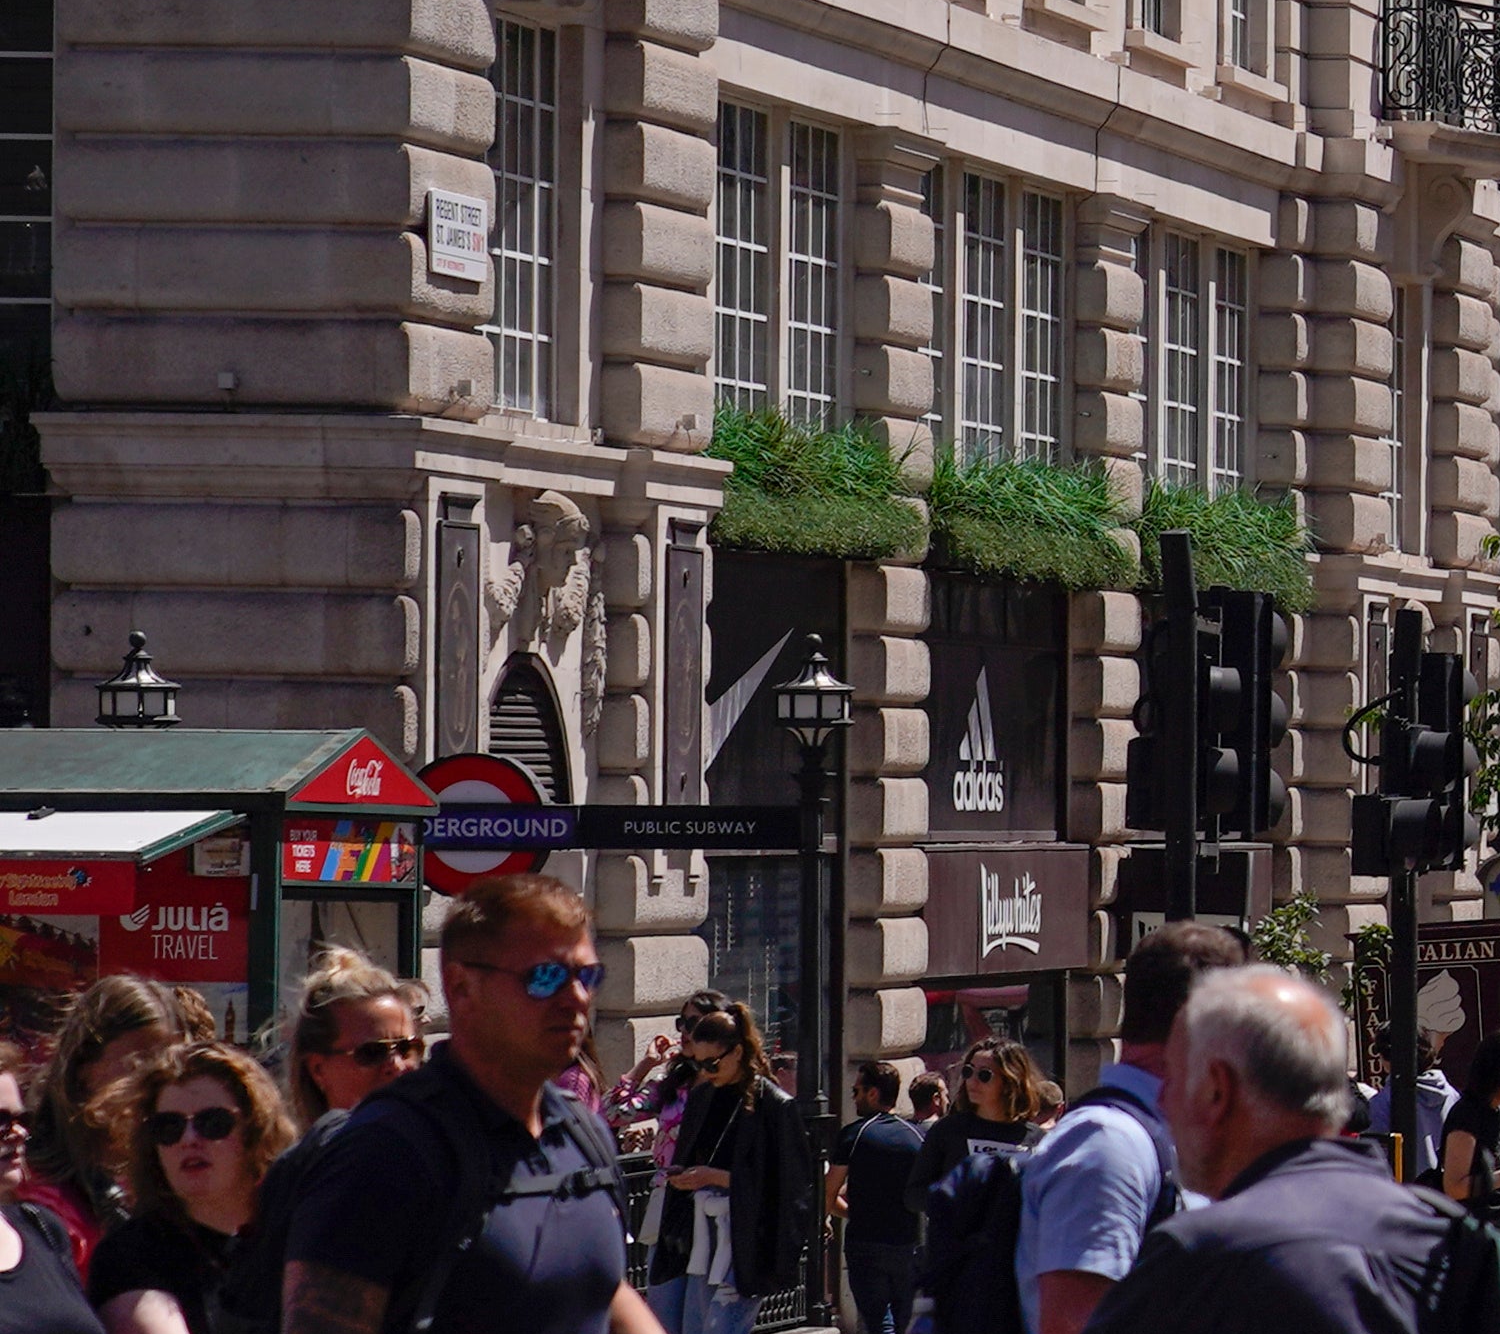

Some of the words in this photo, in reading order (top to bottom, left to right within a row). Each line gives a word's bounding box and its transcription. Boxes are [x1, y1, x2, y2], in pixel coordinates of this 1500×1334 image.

[953, 760, 1004, 812] adidas
[424, 818, 568, 838] DERGROUND
[624, 821, 681, 835] PUBLIC
[686, 821, 757, 835] SUBWAY
[151, 934, 218, 960] TRAVEL
[1417, 940, 1495, 961] TALIAN
